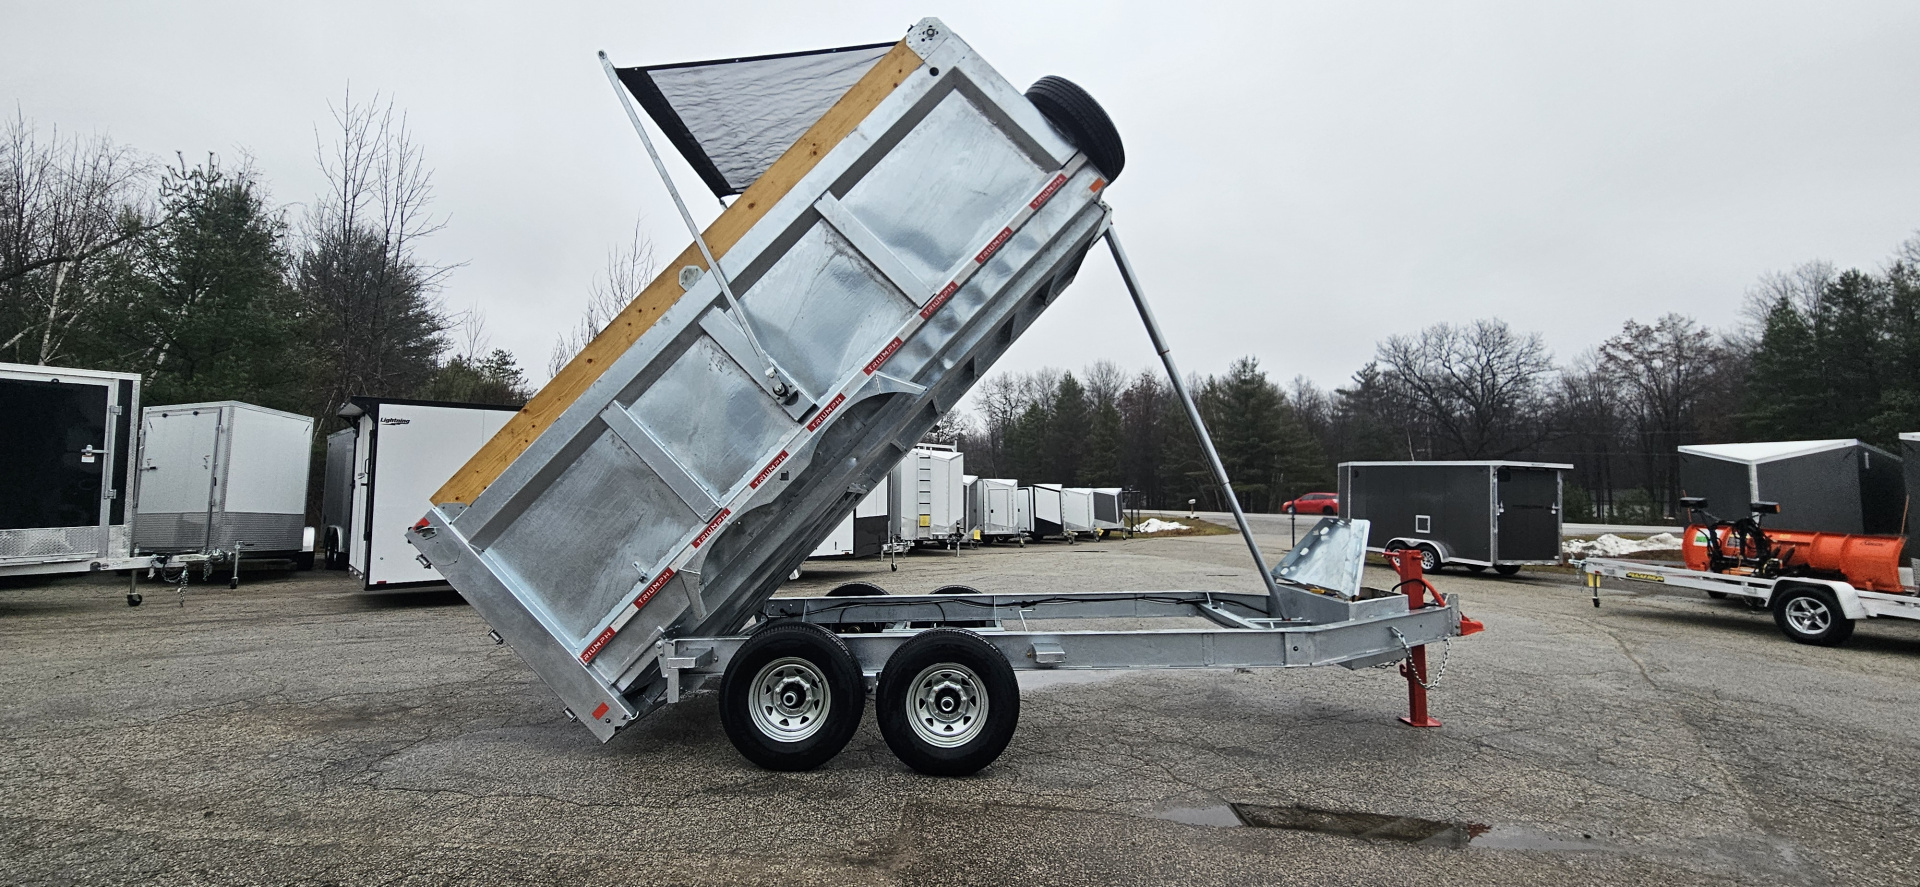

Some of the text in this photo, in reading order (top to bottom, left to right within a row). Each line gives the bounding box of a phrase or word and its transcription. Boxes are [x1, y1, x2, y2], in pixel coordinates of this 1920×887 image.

[1033, 177, 1064, 207] TRIUMPH
[978, 229, 1009, 261] TRIUMPH
[923, 285, 955, 315] TRIUMPH
[868, 340, 899, 372] TRIUMPH
[380, 417, 411, 425] Lightning
[810, 396, 842, 428] TRIUMPH
[754, 454, 786, 486] TRIUMPH
[696, 513, 728, 544] TRIUMPH
[638, 572, 670, 604] TRIUMPH
